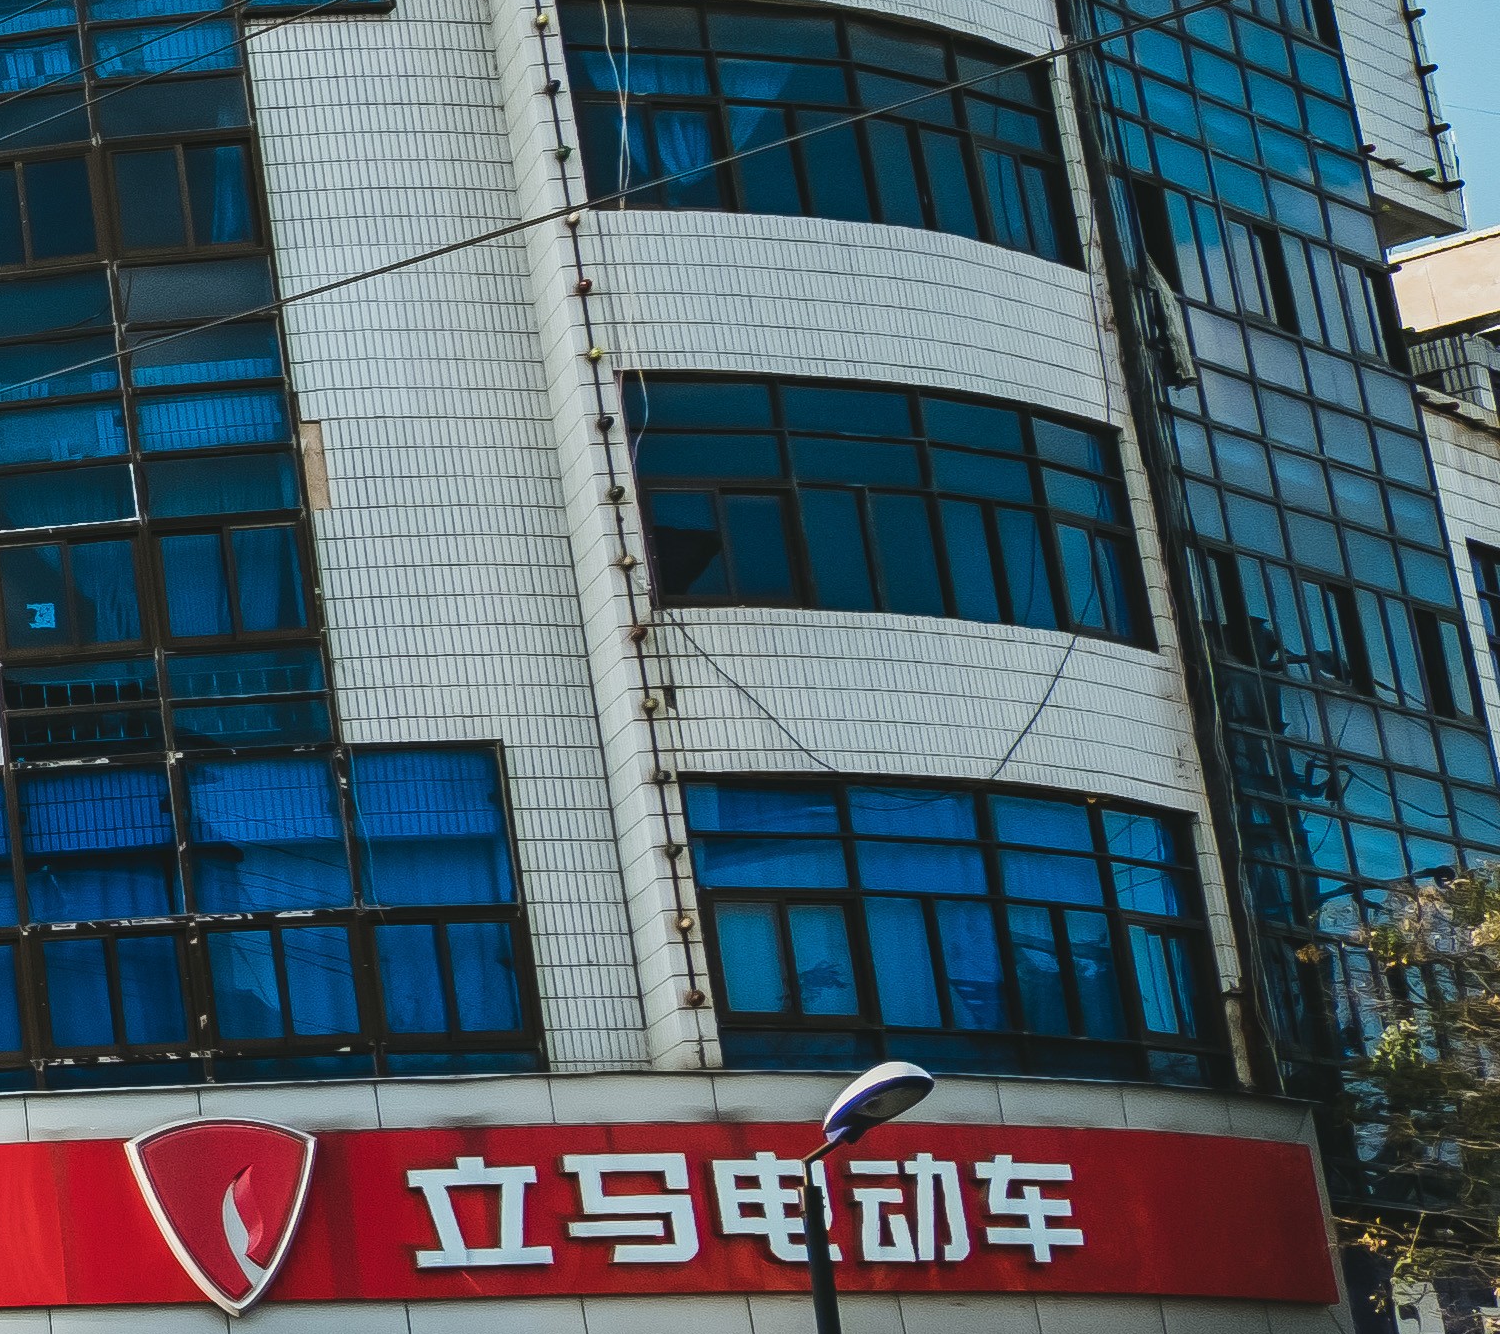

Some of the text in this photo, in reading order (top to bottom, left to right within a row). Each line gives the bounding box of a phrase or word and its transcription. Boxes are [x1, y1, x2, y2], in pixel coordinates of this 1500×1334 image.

[406, 1151, 1084, 1268] 立马电动车
